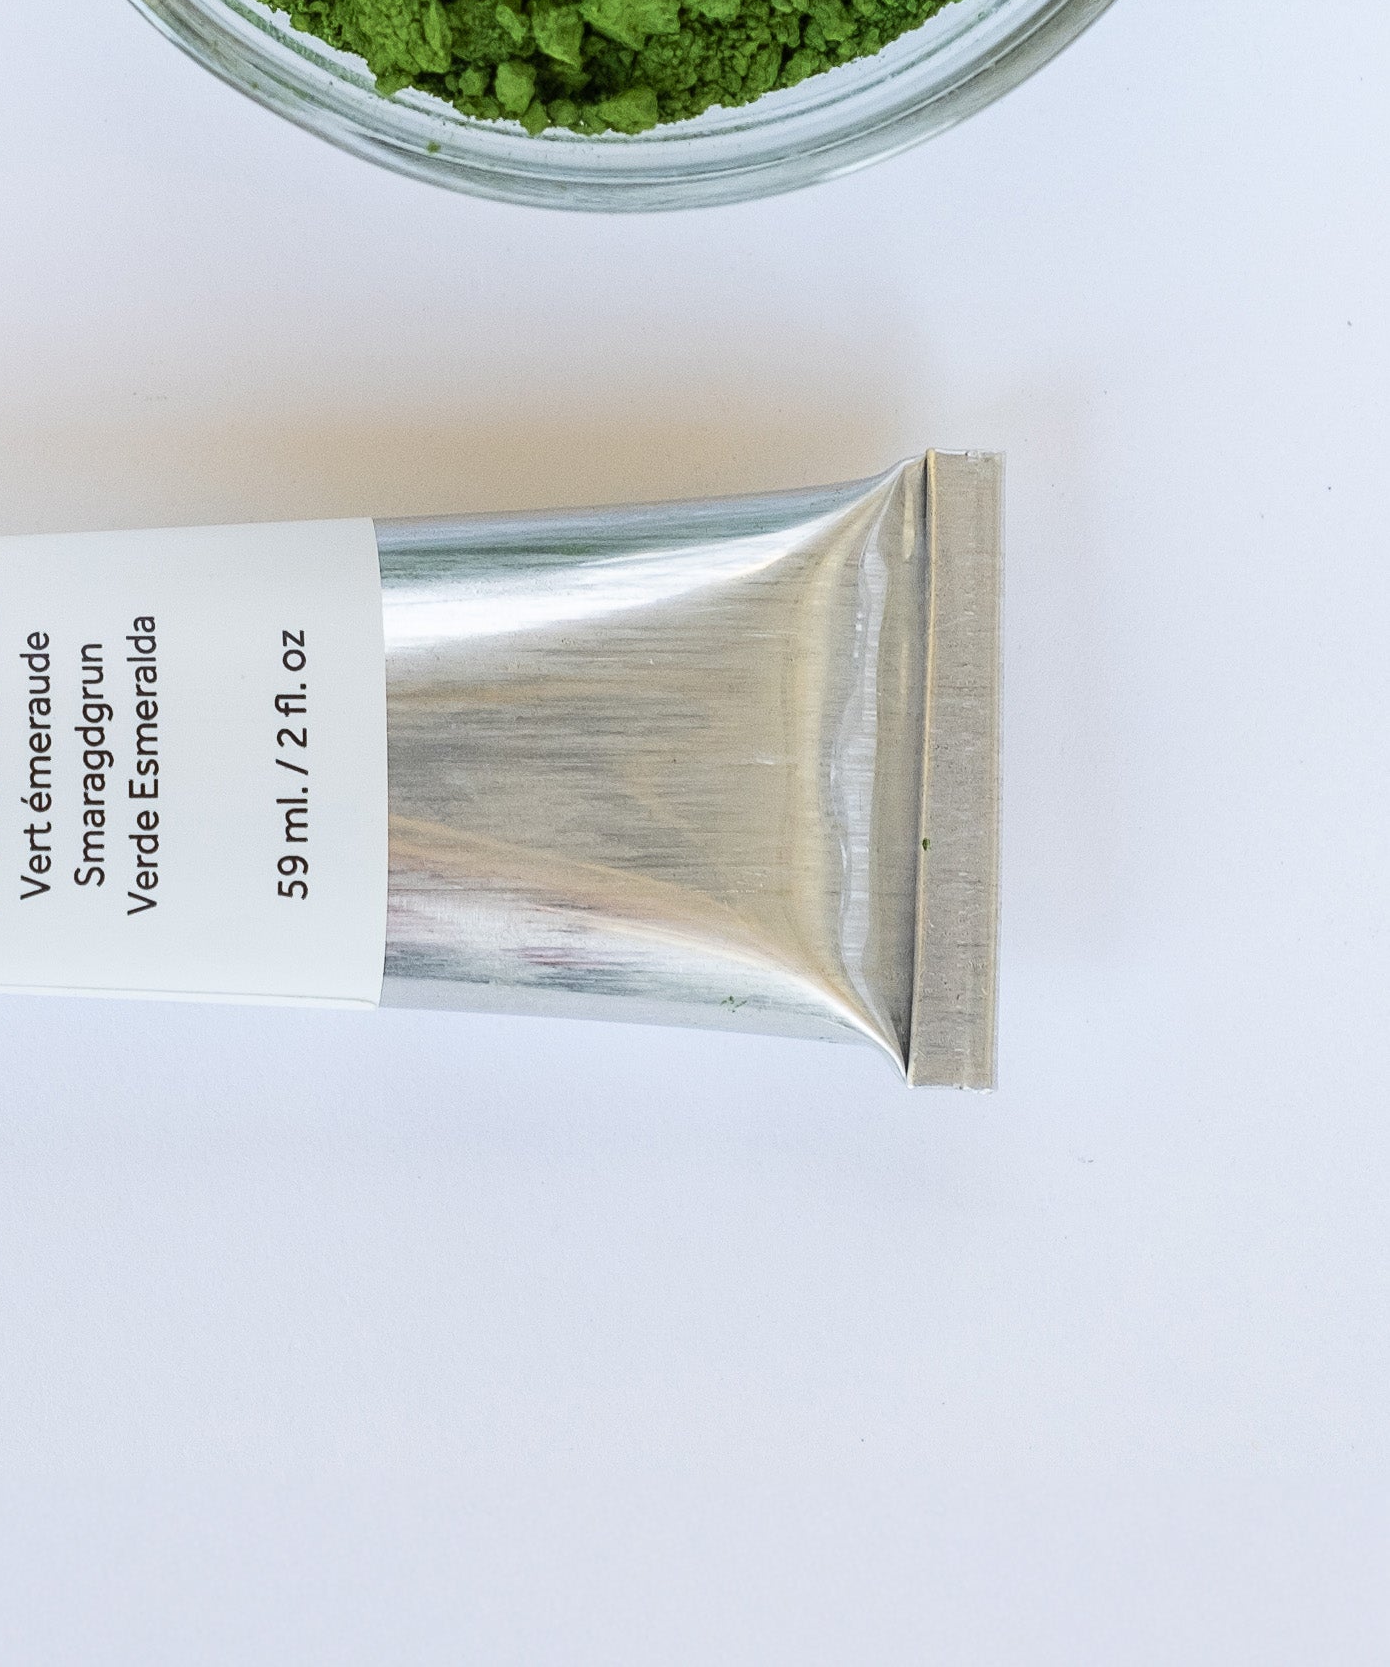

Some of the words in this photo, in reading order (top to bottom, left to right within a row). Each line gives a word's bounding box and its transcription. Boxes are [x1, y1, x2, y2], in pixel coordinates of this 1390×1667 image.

[282, 630, 307, 672] oz
[19, 631, 52, 813] émeraude
[125, 616, 160, 799] Esmeralda
[274, 683, 307, 718] fl.
[73, 643, 115, 887] Smaragdgrun
[276, 727, 308, 748] 2
[275, 758, 309, 776] /
[275, 787, 309, 843] ml.
[20, 821, 52, 900] Vert
[127, 810, 160, 915] Verde
[277, 855, 309, 899] 59
